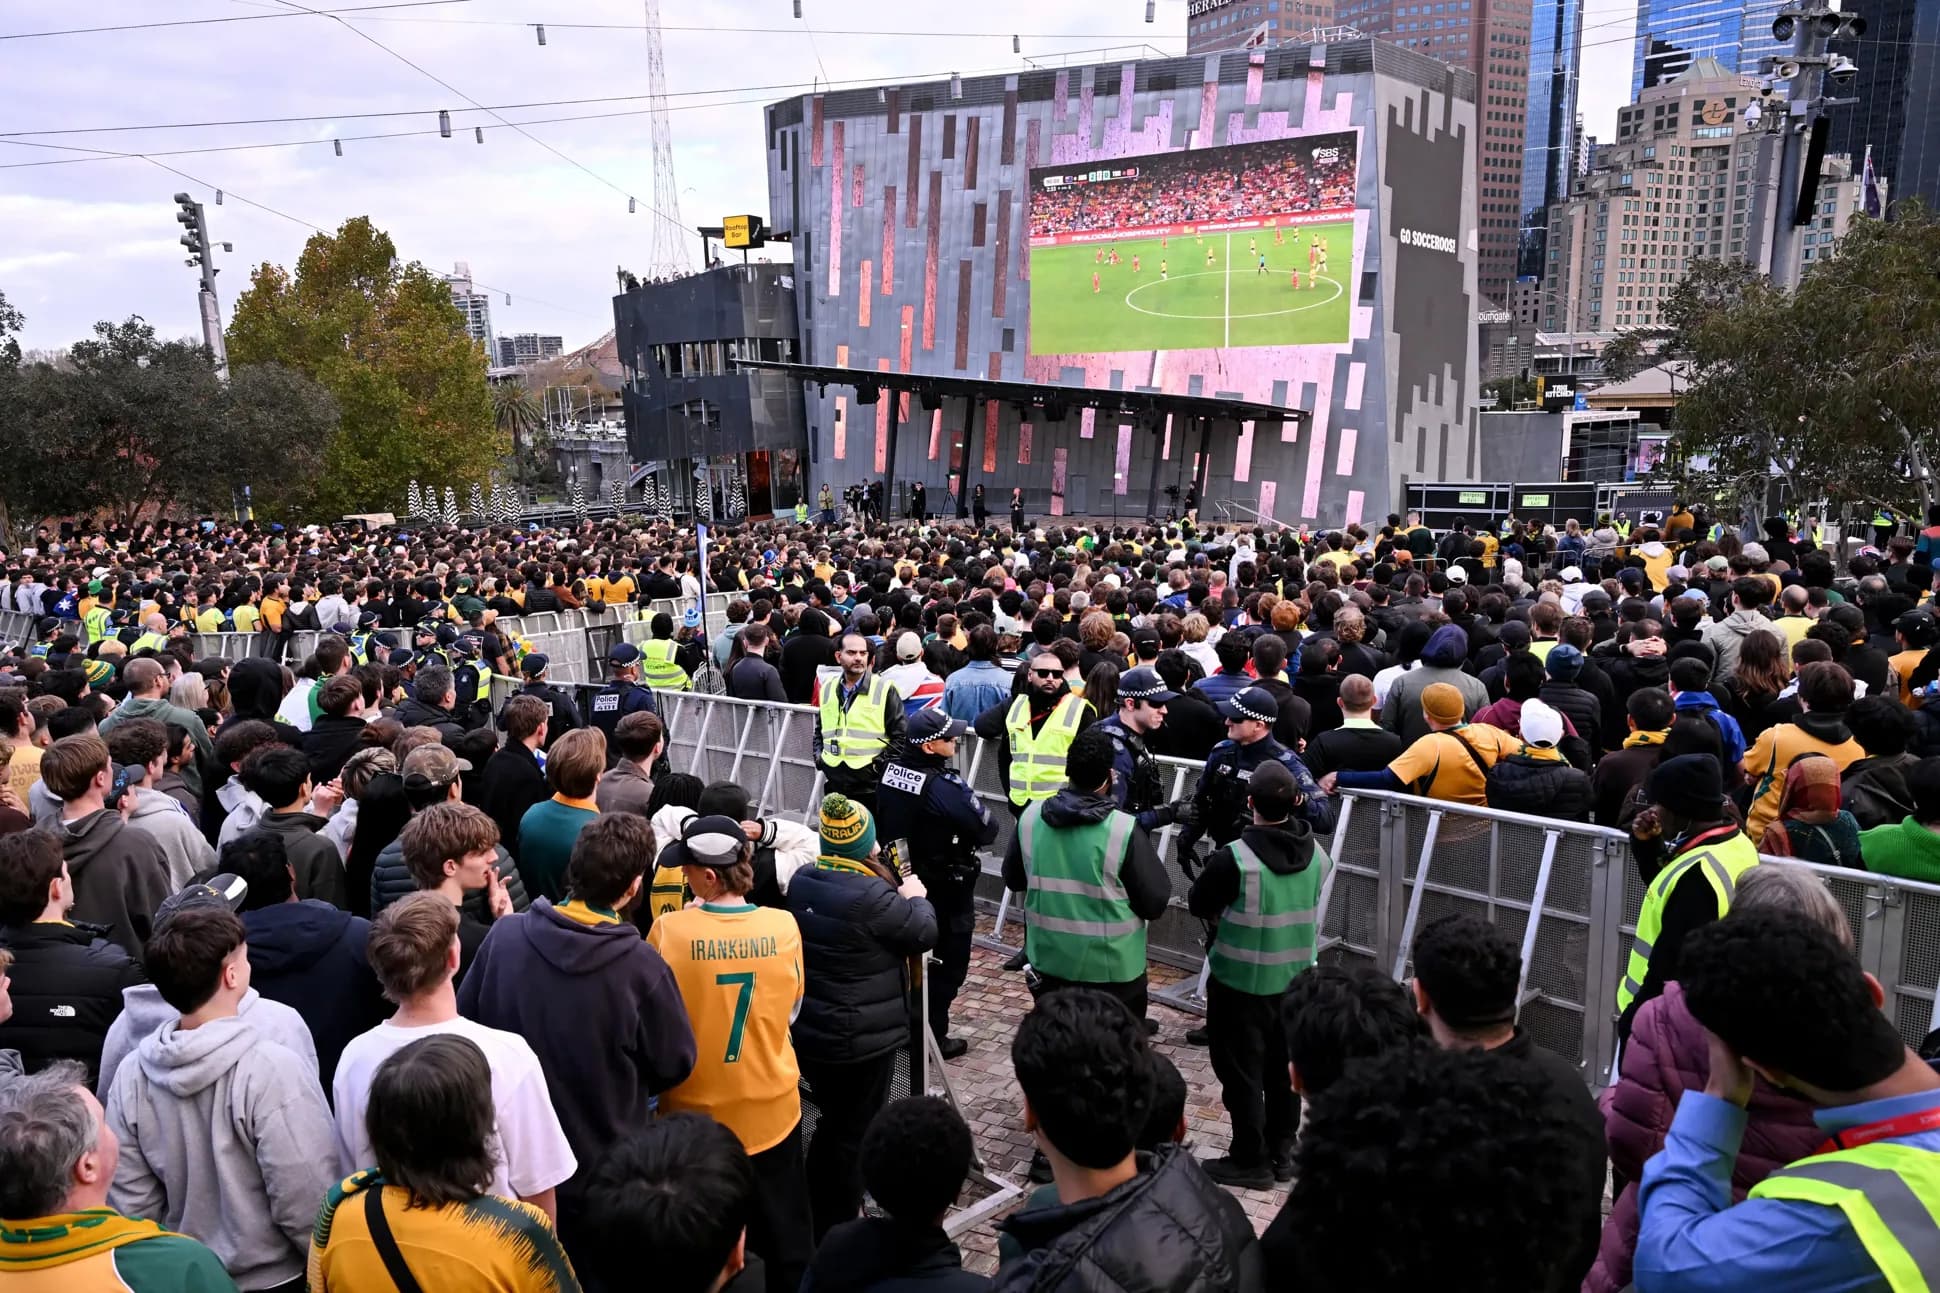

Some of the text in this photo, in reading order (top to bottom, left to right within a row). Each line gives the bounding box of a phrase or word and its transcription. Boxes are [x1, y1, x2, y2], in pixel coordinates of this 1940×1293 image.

[1319, 147, 1339, 158] SBS
[1400, 228, 1456, 254] GO SOCCEROOS!
[1478, 311, 1510, 323] outhgate
[887, 764, 922, 782] Police
[691, 936, 777, 960] IRANKUNDA
[715, 971, 756, 1063] 7
